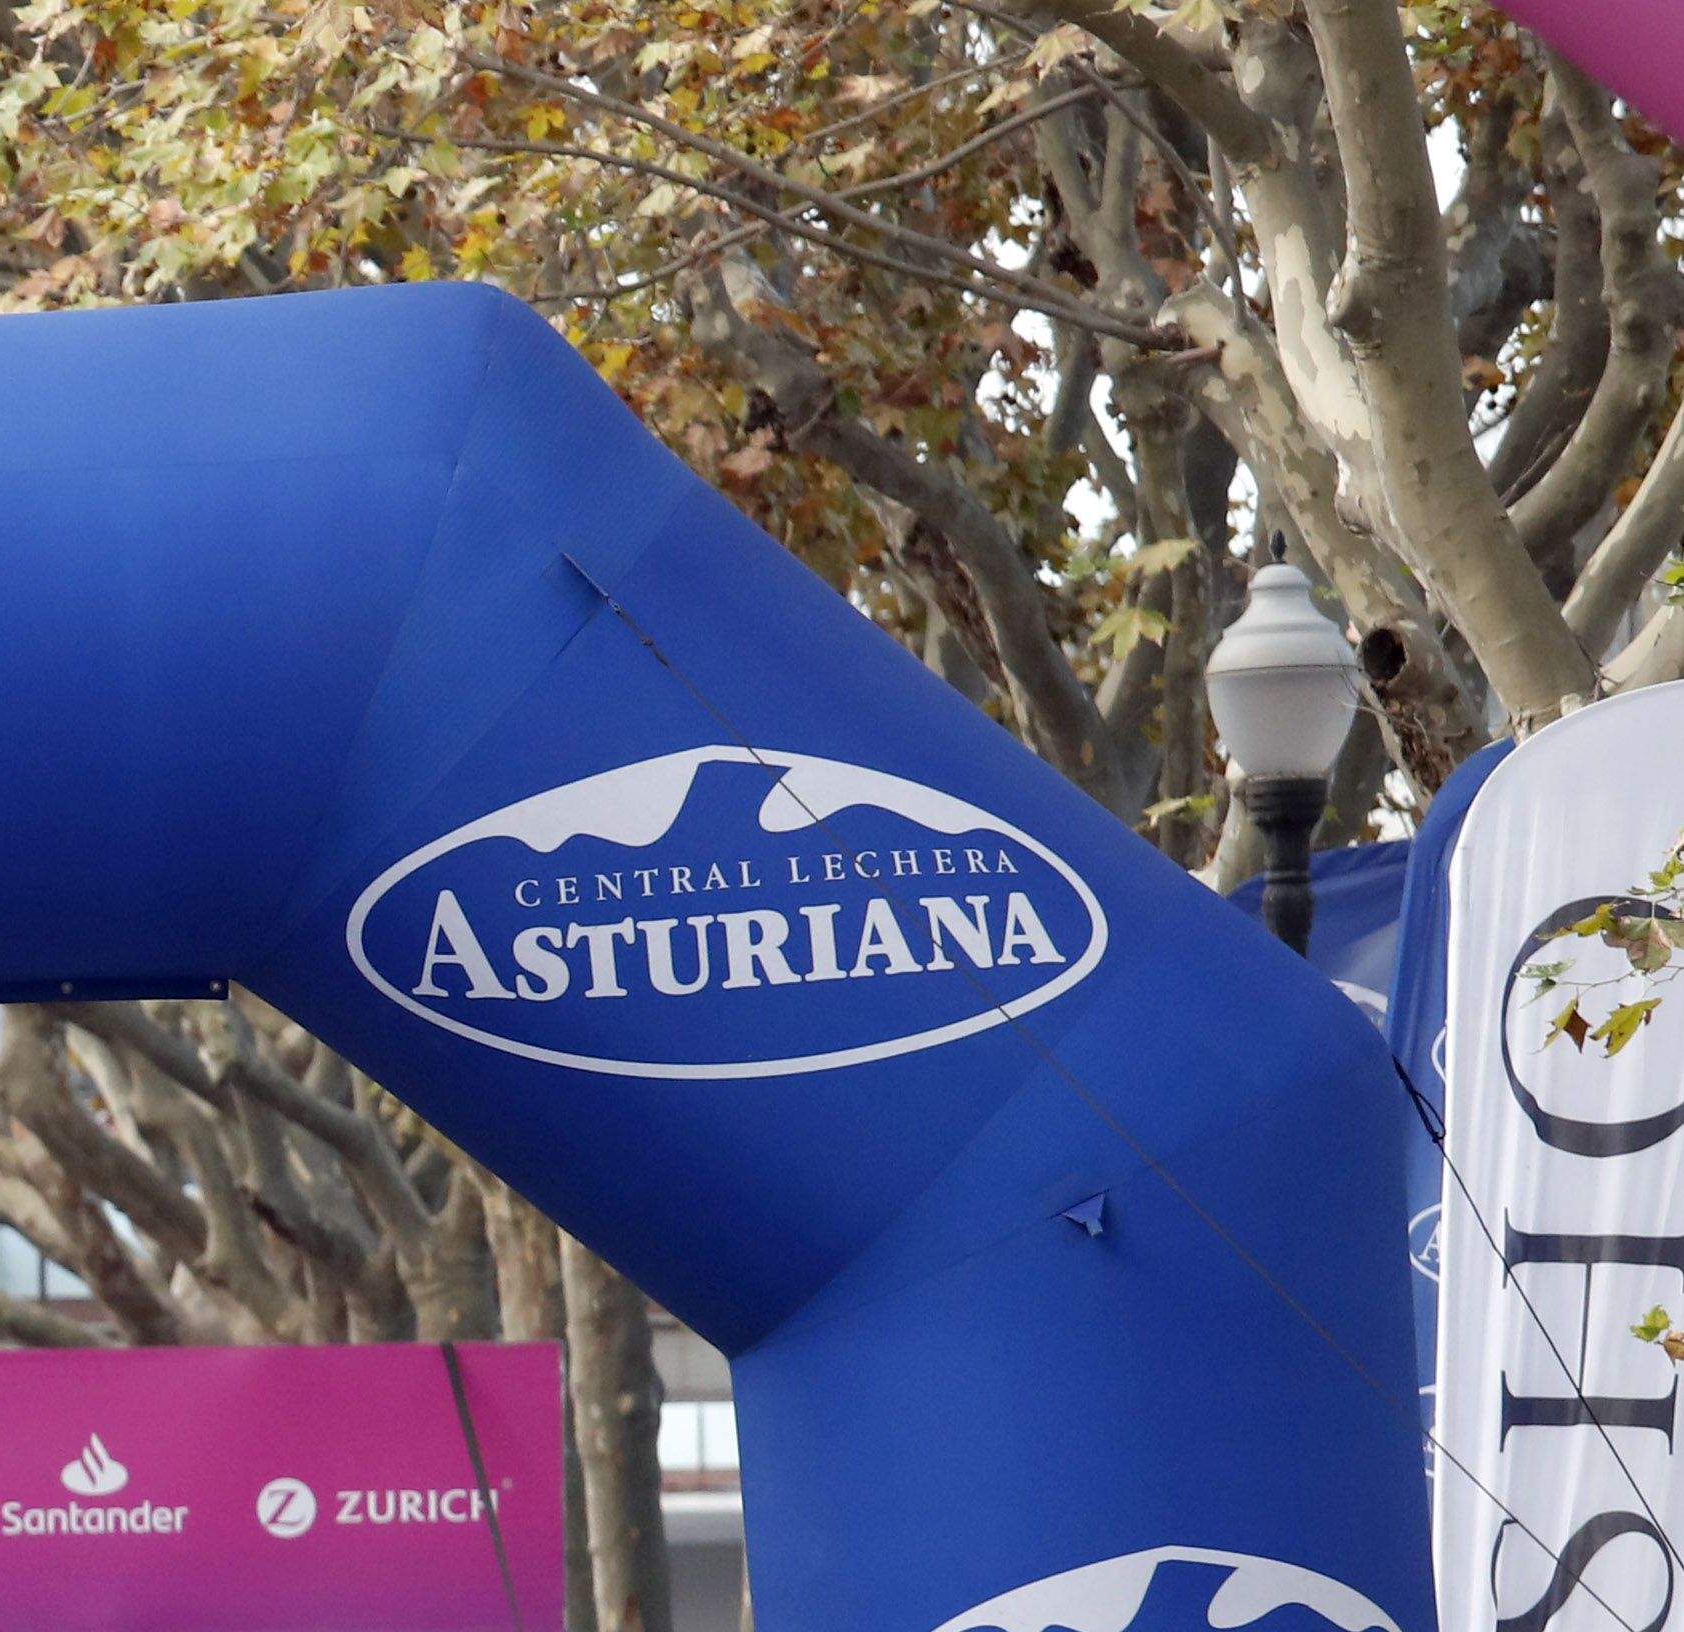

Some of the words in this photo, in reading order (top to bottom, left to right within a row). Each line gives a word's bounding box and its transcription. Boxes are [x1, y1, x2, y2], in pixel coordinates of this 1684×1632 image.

[513, 859, 763, 908] CENTRAL
[788, 847, 1020, 885] LECHERA
[411, 888, 1067, 1003] ASTURIANA
[1, 1499, 189, 1537] Santander
[335, 1488, 499, 1525] ZURICH
